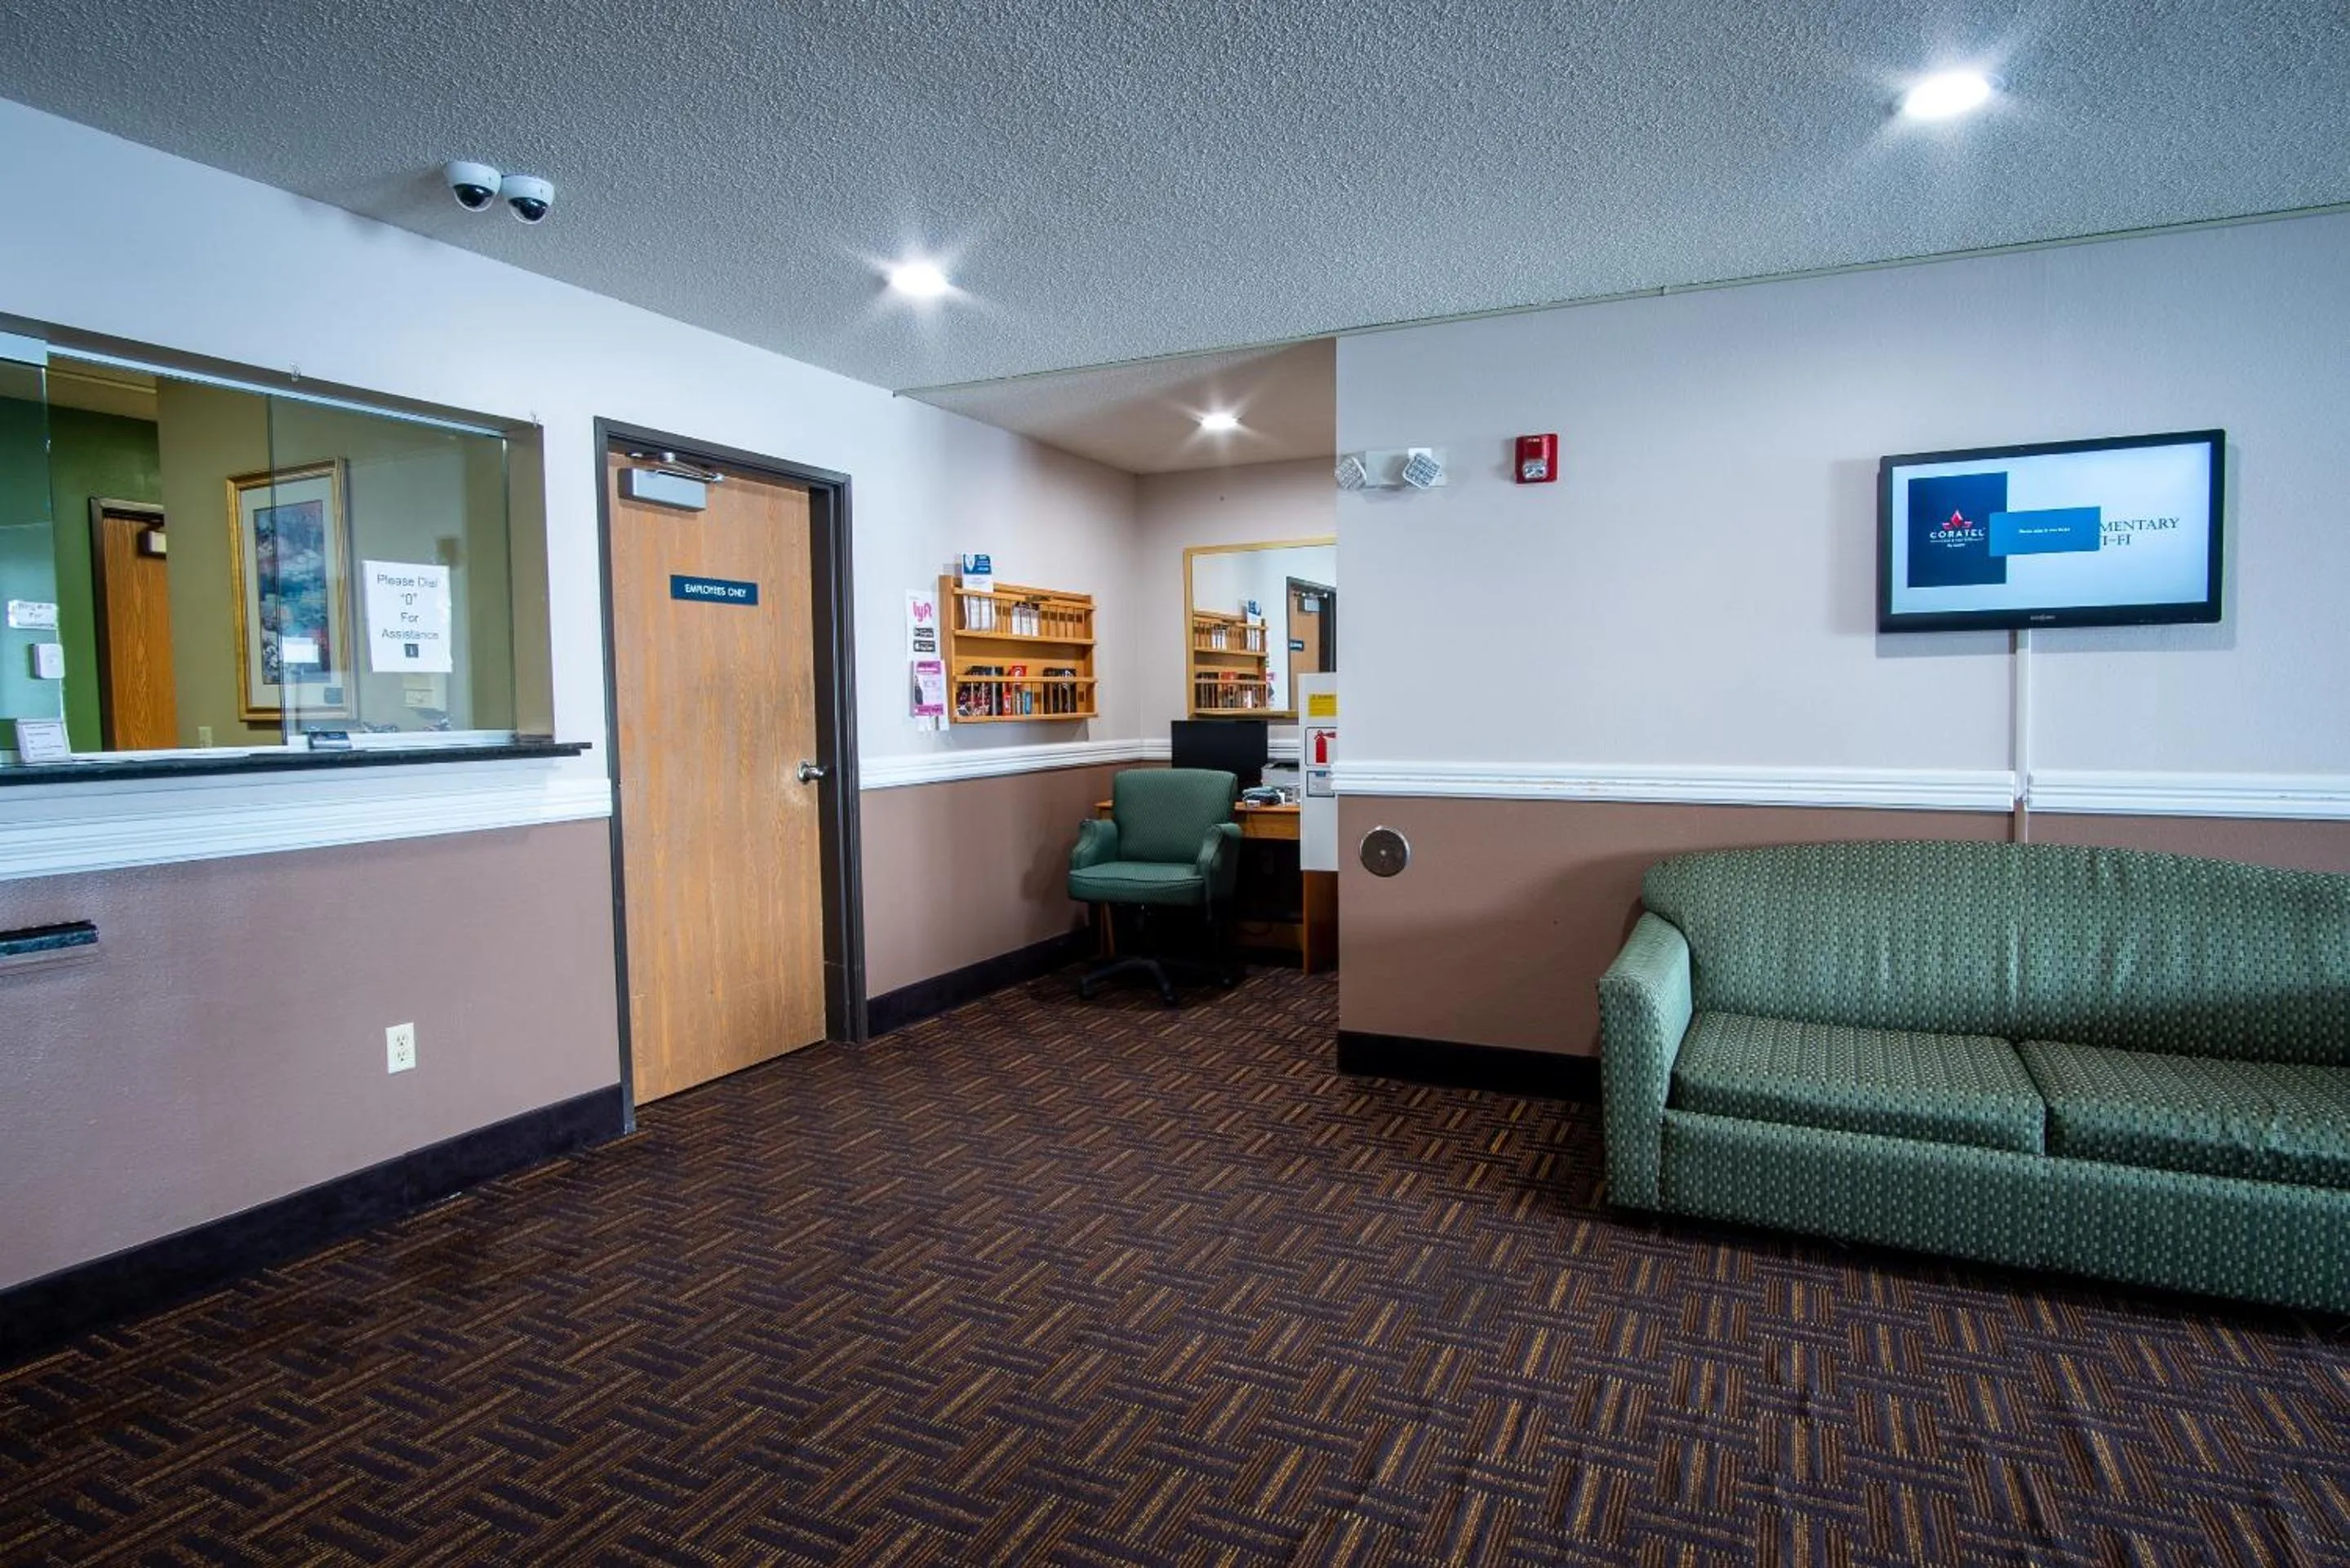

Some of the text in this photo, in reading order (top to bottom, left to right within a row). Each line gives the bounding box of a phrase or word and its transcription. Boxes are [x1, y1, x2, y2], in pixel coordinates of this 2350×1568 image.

[1930, 529, 1984, 539] CORATEL
[377, 574, 438, 588] Please Dial
[685, 584, 746, 597] EMPLOYEES ONLY
[401, 611, 419, 622] For
[913, 601, 932, 622] lyft
[381, 629, 439, 640] Assistance
